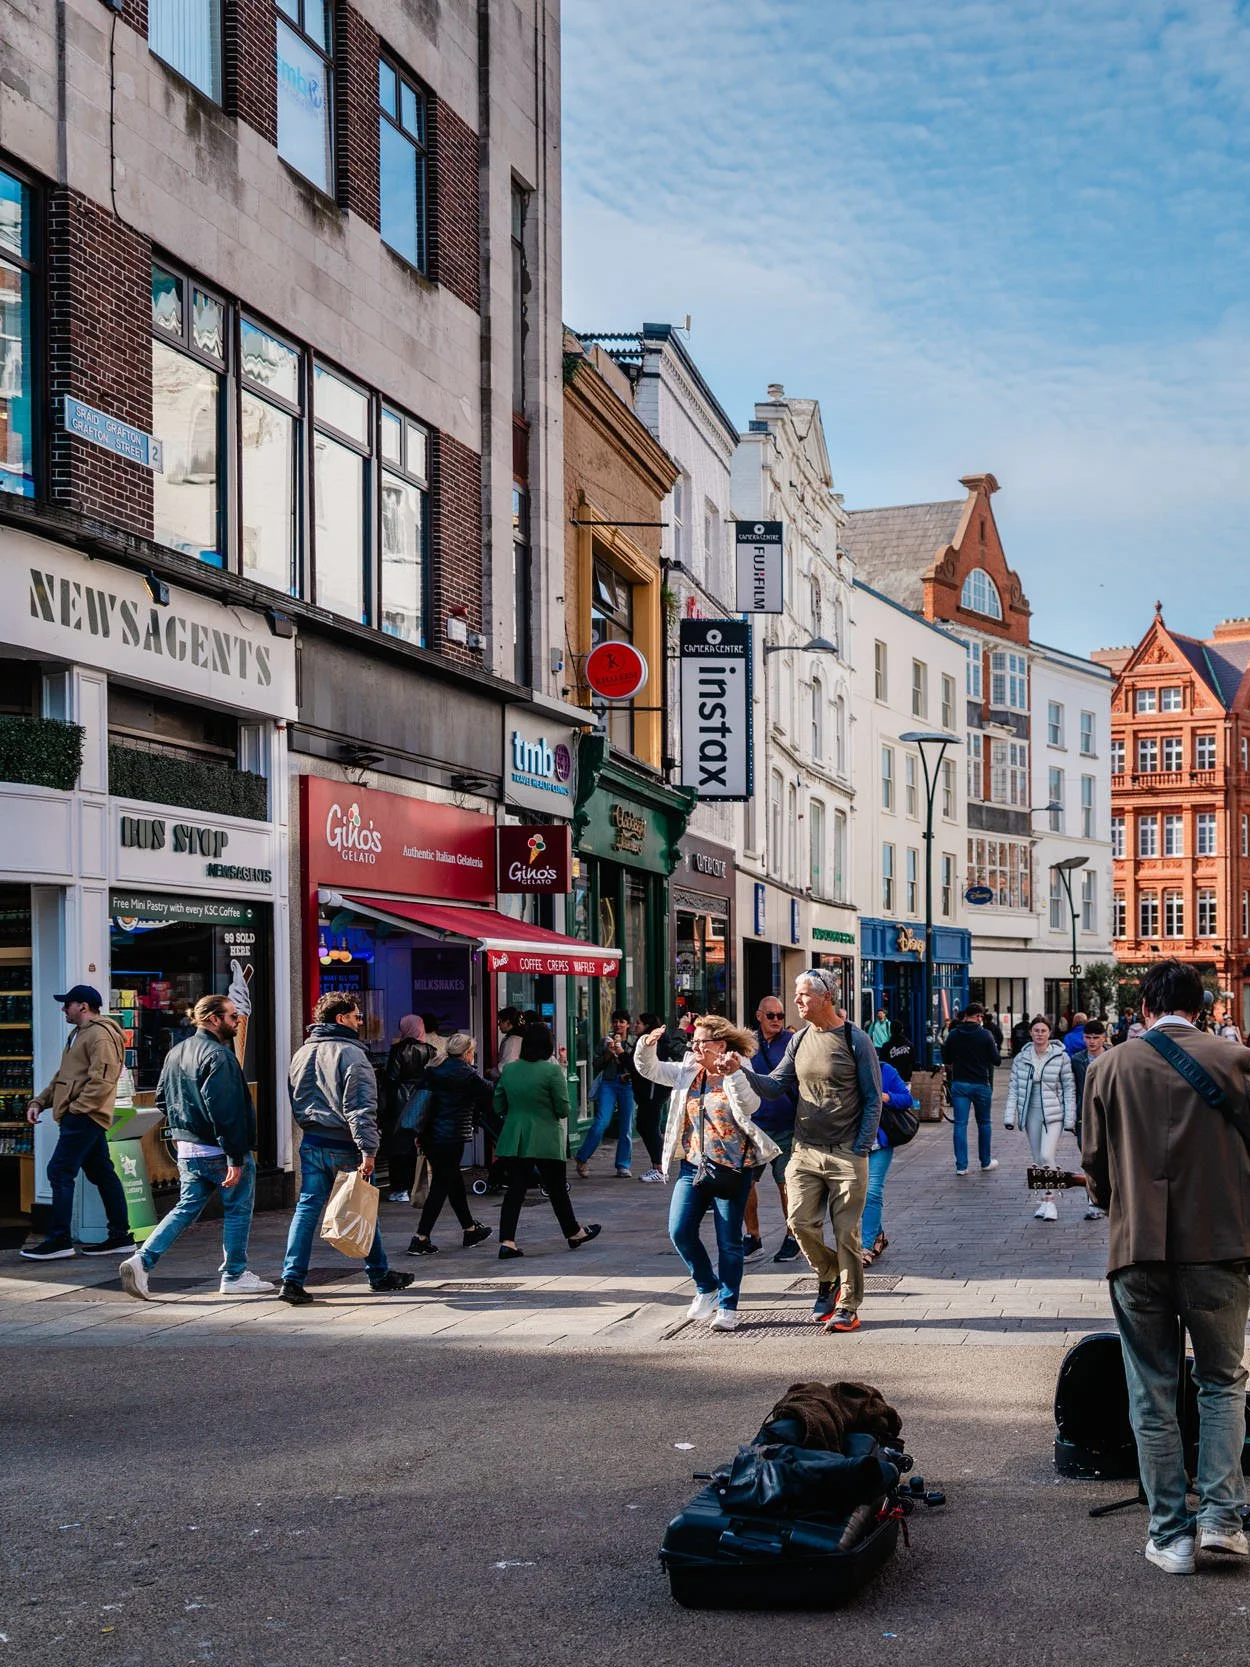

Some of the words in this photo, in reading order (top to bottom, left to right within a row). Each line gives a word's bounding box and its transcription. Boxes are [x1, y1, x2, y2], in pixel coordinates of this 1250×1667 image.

[280, 59, 307, 96] mb
[72, 419, 108, 443] GRAFTON
[115, 439, 144, 459] STREET
[105, 421, 141, 446] GRAFTON
[152, 446, 159, 461] 2
[753, 546, 765, 610] FUJIFILM
[29, 568, 272, 687] NEWSAGENTS
[684, 644, 715, 653] CAMERA
[715, 645, 744, 654] CENTRE
[698, 666, 737, 787] instax
[512, 730, 555, 778] tmb
[532, 778, 552, 792] HEALTH
[121, 817, 166, 850] BUS
[173, 823, 229, 858] STOP
[326, 803, 382, 852] Gino's
[342, 849, 376, 864] GELATO
[402, 846, 434, 861] Authentic
[435, 850, 456, 864] Italian
[456, 853, 484, 868] Gelateria
[206, 862, 272, 883] NEWSAGENTS
[508, 861, 557, 882] Gino's
[521, 877, 552, 885] GELATO
[113, 897, 129, 909] Free
[130, 899, 146, 910] Mini
[146, 900, 168, 914] Pastry
[170, 903, 184, 913] with
[185, 906, 203, 917] every
[204, 906, 218, 916] KSC
[219, 907, 240, 918] Coffee
[224, 932, 235, 943] 99
[236, 932, 256, 944] SOLD
[229, 946, 251, 956] HERE
[520, 958, 543, 971] COFFEE
[547, 960, 569, 972] CREPES
[573, 961, 595, 973] WAFFLES
[414, 979, 465, 991] MILKSHAKES
